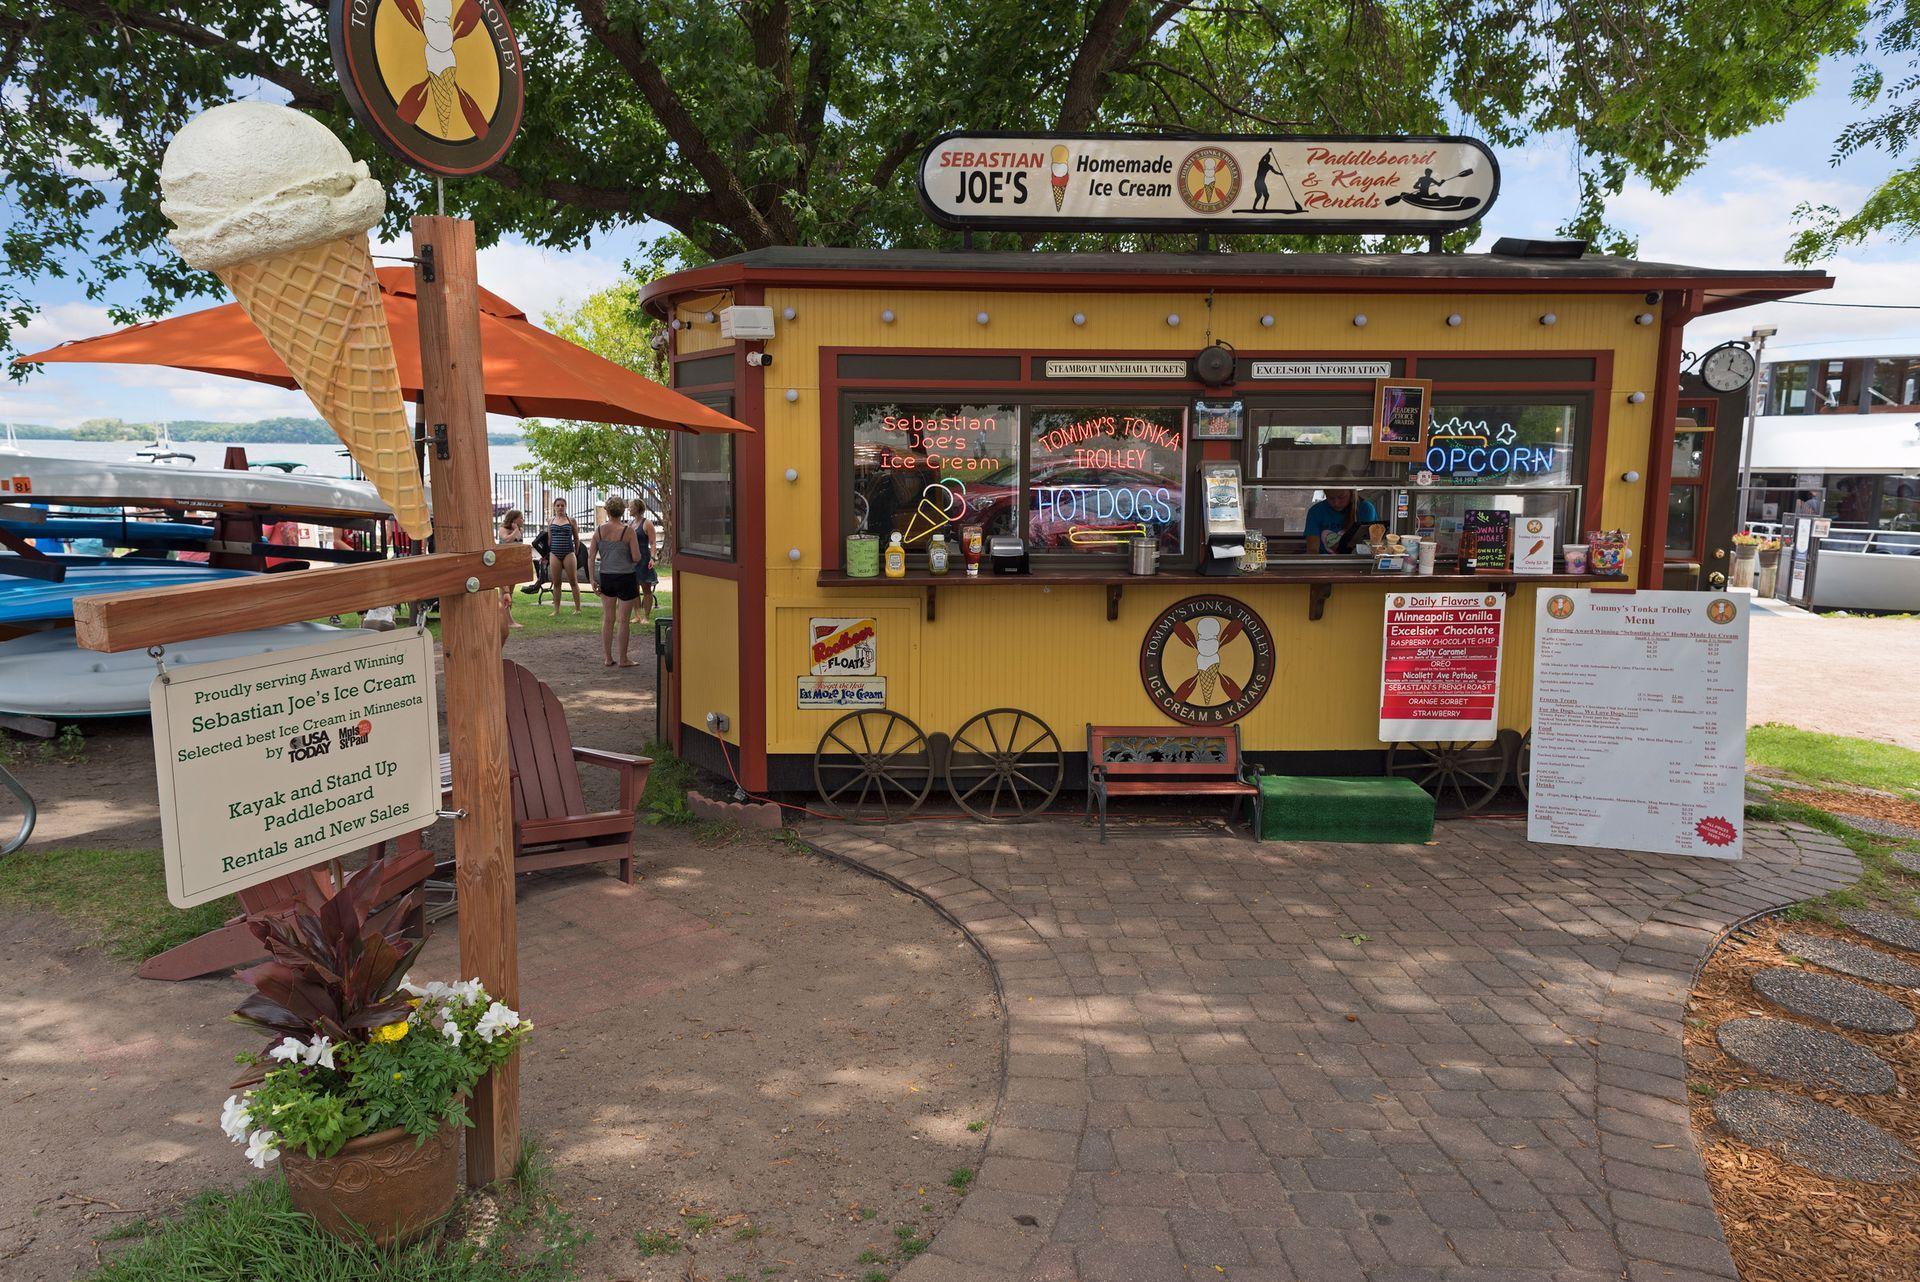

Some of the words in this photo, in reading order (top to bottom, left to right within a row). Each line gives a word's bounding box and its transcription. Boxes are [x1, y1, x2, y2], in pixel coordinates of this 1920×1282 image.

[480, 0, 518, 75] ROLLEY
[939, 151, 1044, 168] SEBASTIAN
[1076, 154, 1173, 174] Homemade
[1306, 147, 1437, 166] Paddleboard
[956, 171, 1029, 205] JOE'S
[1089, 179, 1113, 197] Ice
[1118, 179, 1172, 197] Cream
[1301, 172, 1321, 187] &
[1326, 170, 1401, 194] Kayak
[1303, 190, 1381, 209] Rentals
[1048, 363, 1098, 374] STEAMBOAT
[1099, 364, 1148, 375] MINNEHAHA
[1149, 364, 1185, 375] TICKETS
[1256, 364, 1312, 375] EXCELSIOR
[1315, 364, 1388, 376] INFORMATION
[882, 415, 996, 431] Sebastian
[909, 433, 967, 450] Joe's
[1038, 416, 1115, 453] TOMMY'S
[1123, 417, 1181, 452] TONKA
[880, 453, 916, 468] Ice
[926, 453, 999, 470] Cream
[1074, 448, 1146, 469] TROLLEY
[1424, 446, 1556, 473] OPCORN
[1037, 487, 1092, 523] HOT
[1096, 487, 1172, 523] DOGS
[1475, 525, 1505, 534] OWNIE
[1410, 597, 1437, 608] Daily
[1441, 596, 1479, 606] Flavors
[1590, 604, 1629, 613] Tommy's
[1631, 605, 1658, 613] Tonka
[1661, 606, 1692, 615] Trolley
[1394, 612, 1454, 624] Minneapolis
[1458, 611, 1493, 621] Vanilla
[1625, 615, 1655, 625] Menu
[1146, 607, 1187, 657] TOMMY'S
[1188, 600, 1233, 615] TONKA
[1236, 609, 1269, 658] TROLLEY
[1391, 626, 1439, 636] Excelsior
[1443, 626, 1494, 636] Chocolate
[1391, 639, 1431, 647] RASPBERRY
[1417, 648, 1436, 657] Salty
[1438, 647, 1467, 656] Caramel
[828, 656, 865, 669] FLOATS
[1430, 660, 1451, 668] OREO
[194, 684, 252, 705] Proudly
[255, 671, 307, 691] serving
[309, 662, 352, 681] Award
[354, 652, 405, 671] Winning
[1436, 672, 1450, 680] Ave
[1452, 672, 1478, 680] Pothole
[813, 688, 839, 700] More
[841, 688, 855, 700] Ice
[856, 688, 884, 701] Cream
[1467, 683, 1492, 691] ROAST
[191, 701, 284, 733] Sebastian
[287, 690, 330, 716] Joe's
[334, 684, 359, 701] Ice
[363, 673, 417, 693] Cream
[1147, 674, 1166, 699] ICE
[1163, 697, 1208, 721] CREAM
[1215, 710, 1223, 720] &
[1227, 673, 1266, 716] KAYAKS
[1412, 709, 1461, 717] STRAWBERRY
[177, 737, 243, 763] Selected
[246, 730, 277, 746] best
[279, 724, 300, 738] Ice
[302, 712, 347, 733] Cream
[349, 709, 361, 721] in
[363, 694, 424, 718] Minnesota
[338, 725, 360, 741] Mpls
[301, 730, 330, 748] USA
[339, 737, 349, 750] St
[349, 732, 369, 748] Paul
[265, 745, 284, 760] by
[288, 740, 332, 763] TODAY
[228, 791, 286, 821] Kayak
[290, 780, 324, 801] and
[327, 766, 373, 791] Stand
[375, 760, 398, 777] Up
[264, 786, 375, 832] Paddleboard
[221, 840, 289, 873] Rentals
[294, 827, 327, 850] and
[330, 815, 367, 838] New
[370, 803, 410, 825] Sales
